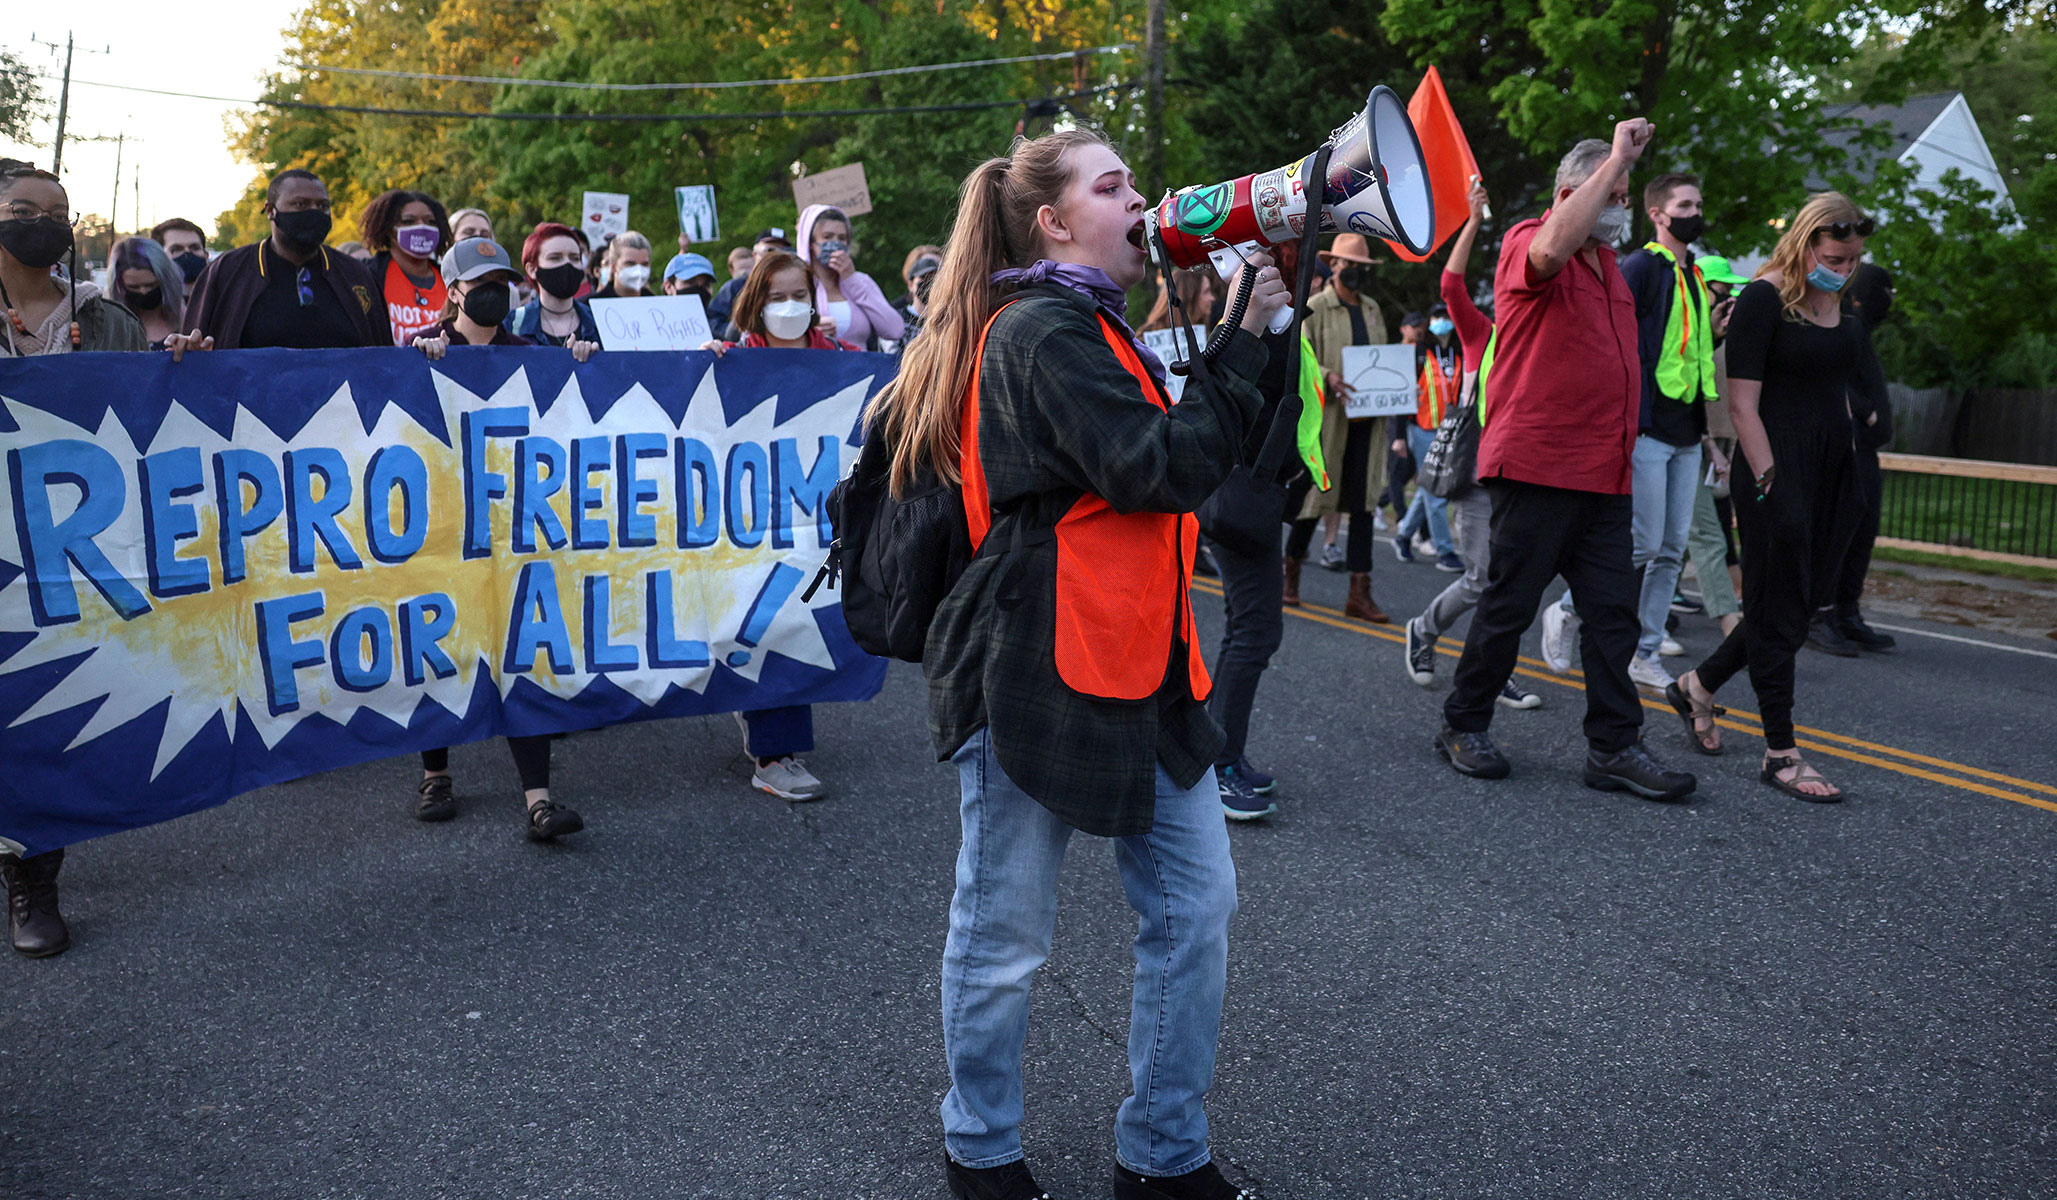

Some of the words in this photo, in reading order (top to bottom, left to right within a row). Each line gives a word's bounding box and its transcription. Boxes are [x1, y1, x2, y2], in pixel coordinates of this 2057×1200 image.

[390, 302, 422, 325] NOT
[604, 306, 646, 341] OUR
[647, 307, 706, 342] RIGHTS
[7, 439, 429, 628] REPRO
[460, 405, 841, 561] FREEDOM
[255, 591, 457, 718] FOR
